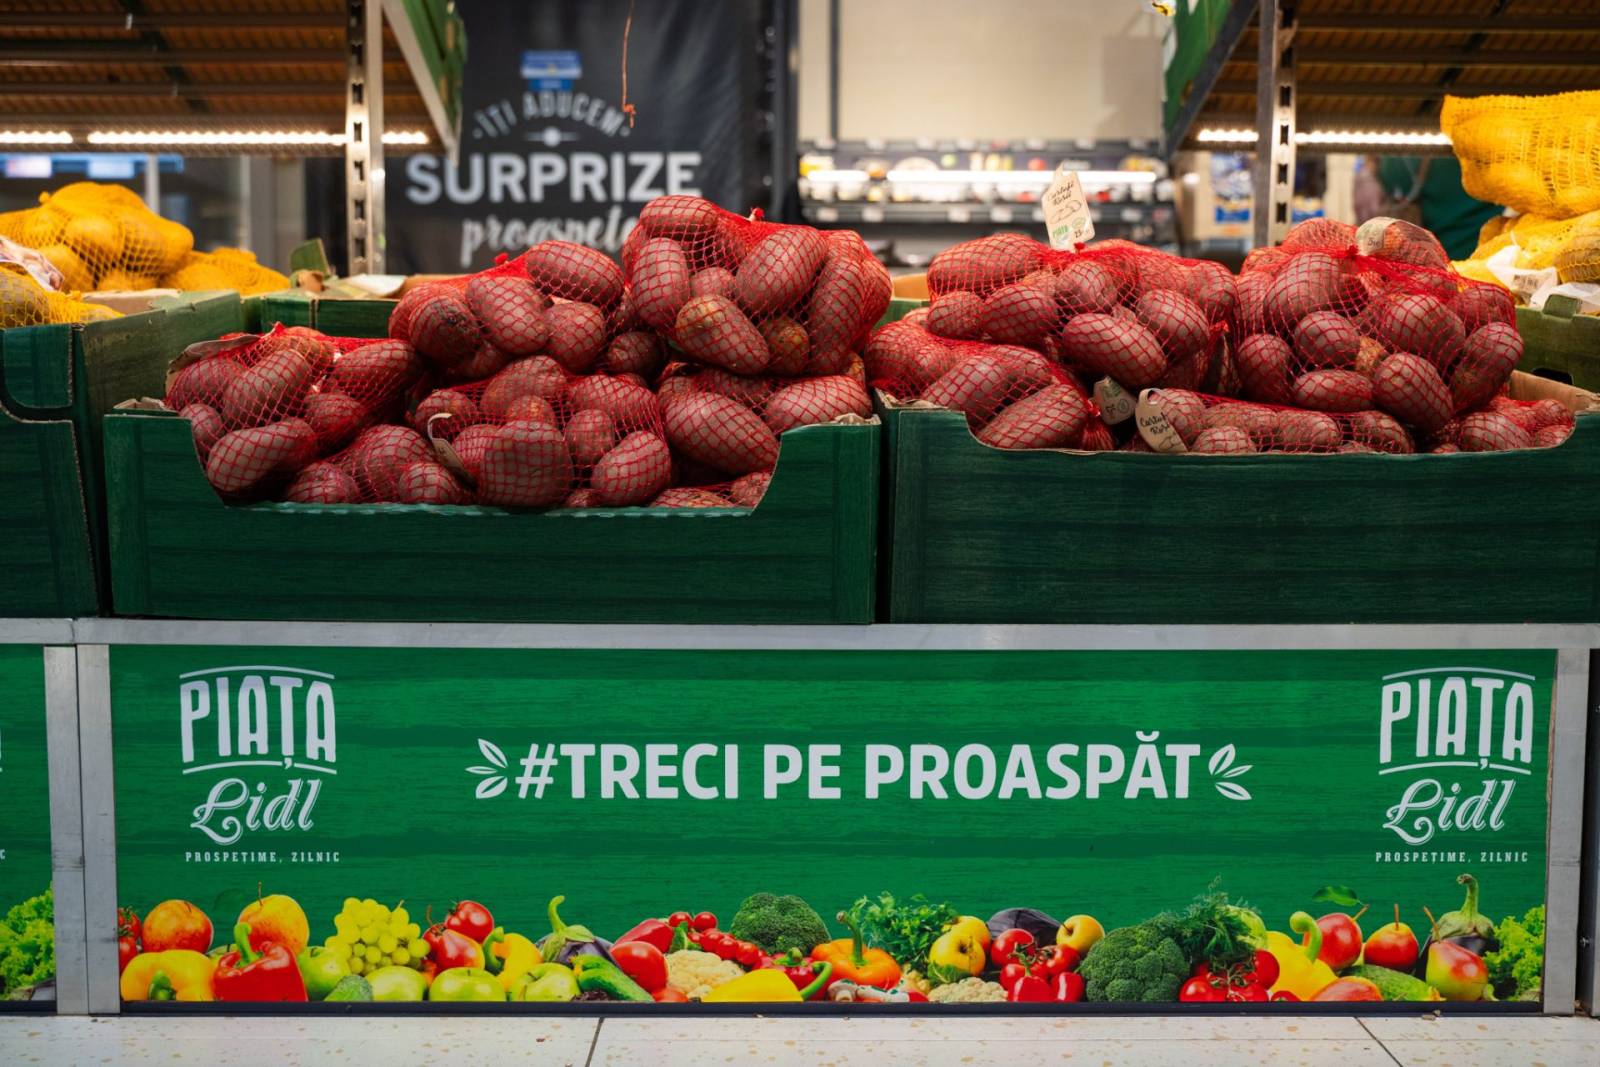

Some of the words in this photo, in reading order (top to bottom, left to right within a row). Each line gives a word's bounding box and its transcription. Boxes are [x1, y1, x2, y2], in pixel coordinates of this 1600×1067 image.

[523, 90, 626, 137] ADUCEM
[405, 153, 702, 204] SURPRIZE
[180, 675, 337, 770] PIAȚA
[1379, 676, 1534, 770] PIAȚA
[515, 743, 739, 799] #TRECI
[763, 743, 842, 799] PE
[865, 730, 1201, 800] PROASPĂT
[190, 777, 322, 845] Lidl
[1383, 778, 1516, 845] Lidl
[291, 851, 340, 862] ZILNIC
[1480, 851, 1528, 862] ZILNIC
